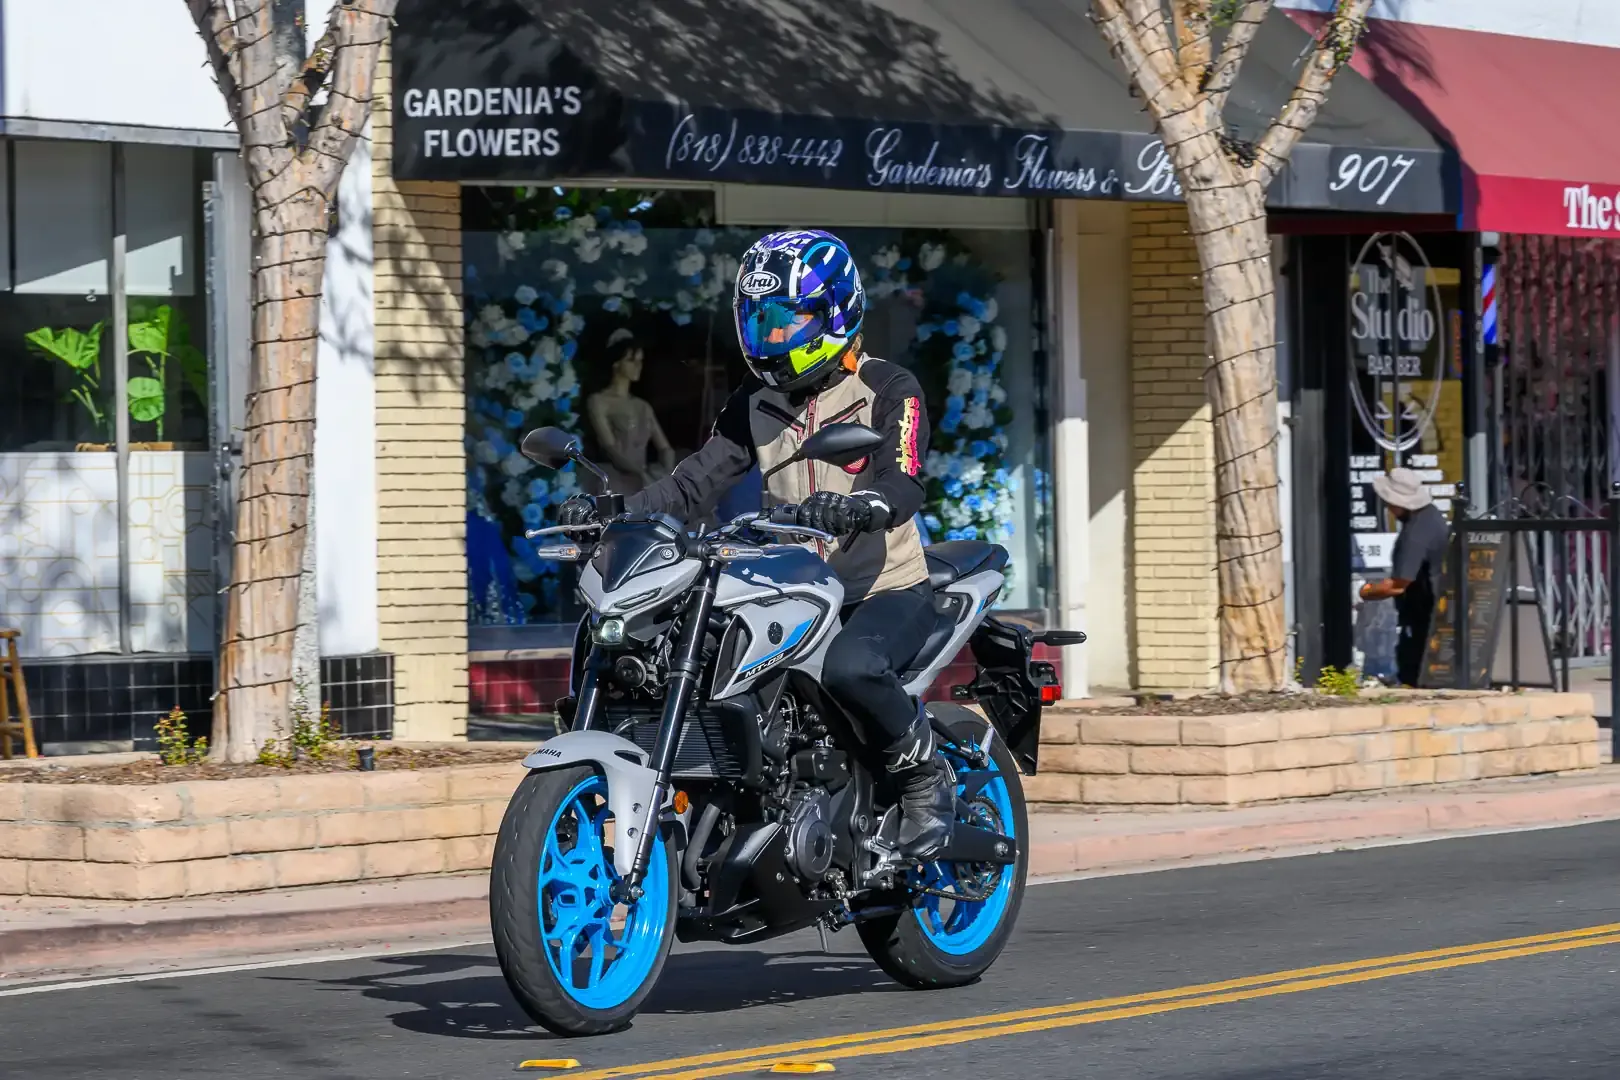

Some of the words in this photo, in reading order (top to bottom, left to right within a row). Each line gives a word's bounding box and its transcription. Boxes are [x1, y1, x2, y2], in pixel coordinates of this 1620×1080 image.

[403, 86, 582, 117] GARDENIA'S
[424, 128, 561, 157] FLOWERS
[665, 114, 738, 171] (818)
[737, 135, 844, 167] 838-4442
[865, 127, 992, 187] Gardenia's
[1003, 134, 1097, 191] Flowers
[1100, 169, 1119, 194] &
[1329, 153, 1416, 205] 907
[1563, 184, 1613, 230] The
[742, 274, 775, 289] Arai
[1351, 291, 1435, 341] Studio
[1367, 354, 1421, 376] BARBER
[744, 652, 785, 678] MT-03
